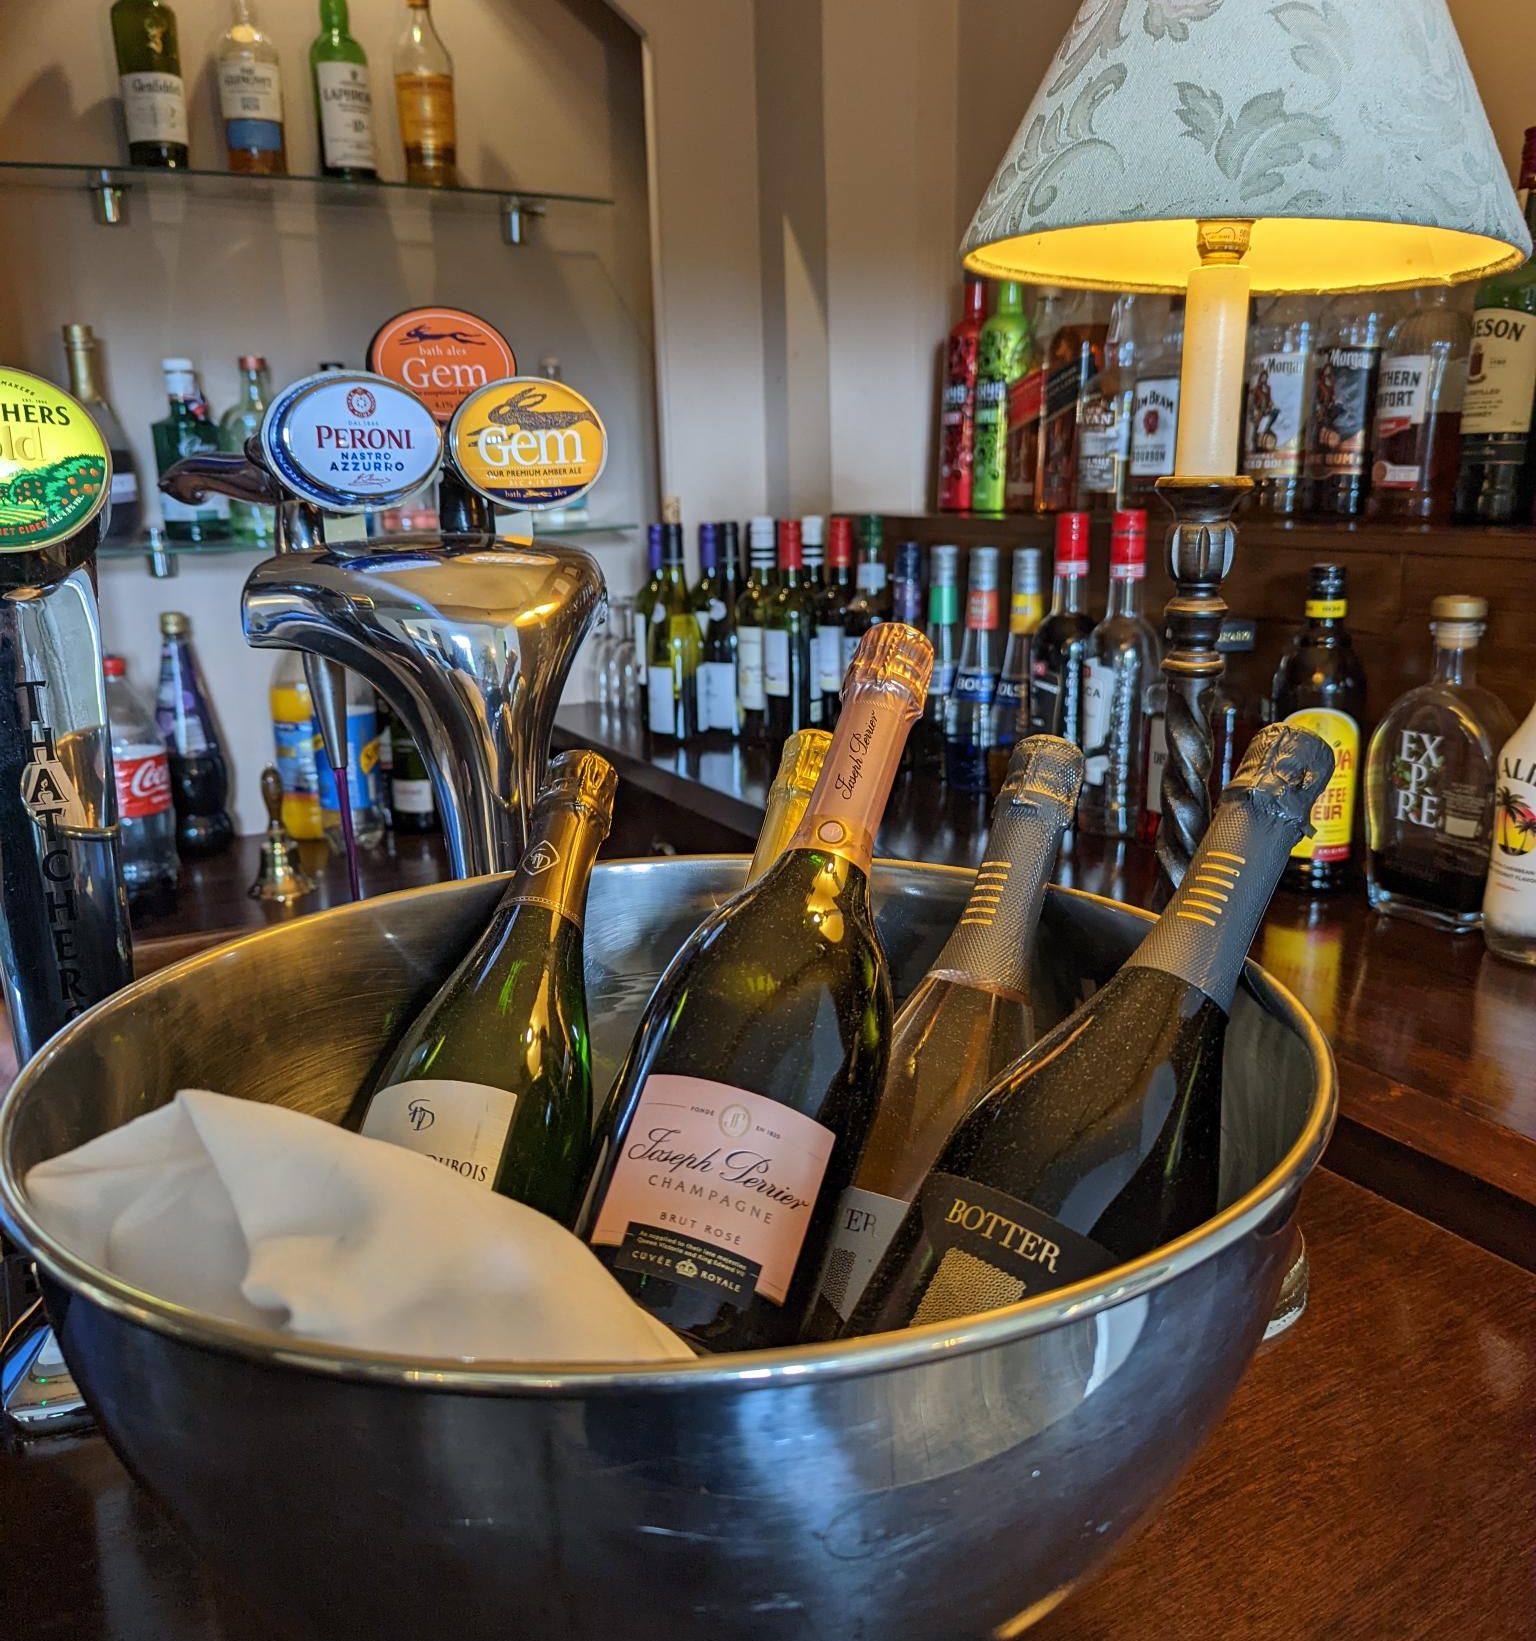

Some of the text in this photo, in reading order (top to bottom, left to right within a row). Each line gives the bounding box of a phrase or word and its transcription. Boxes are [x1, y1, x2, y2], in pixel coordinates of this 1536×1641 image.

[418, 344, 468, 357] bath ales
[402, 356, 488, 388] Gem
[1, 403, 71, 426] HERS
[0, 426, 46, 462] ld
[316, 425, 415, 449] PERONI
[478, 426, 586, 467] Gem
[330, 462, 405, 472] AZZURRO
[341, 452, 392, 460] NASTRO
[506, 469, 541, 477] PREMIUM
[543, 468, 567, 476] AMBER
[504, 489, 522, 498] bath
[18, 520, 48, 535] CIDER
[835, 710, 878, 800] Joseph Perrier
[628, 1128, 809, 1210] Joseph Perrier
[648, 1175, 774, 1225] CHAMPAGNE
[659, 1212, 743, 1246] BRUT ROSÉ
[944, 1198, 1061, 1274] BOTTER
[631, 1251, 743, 1294] CUVÉE ROYALE
